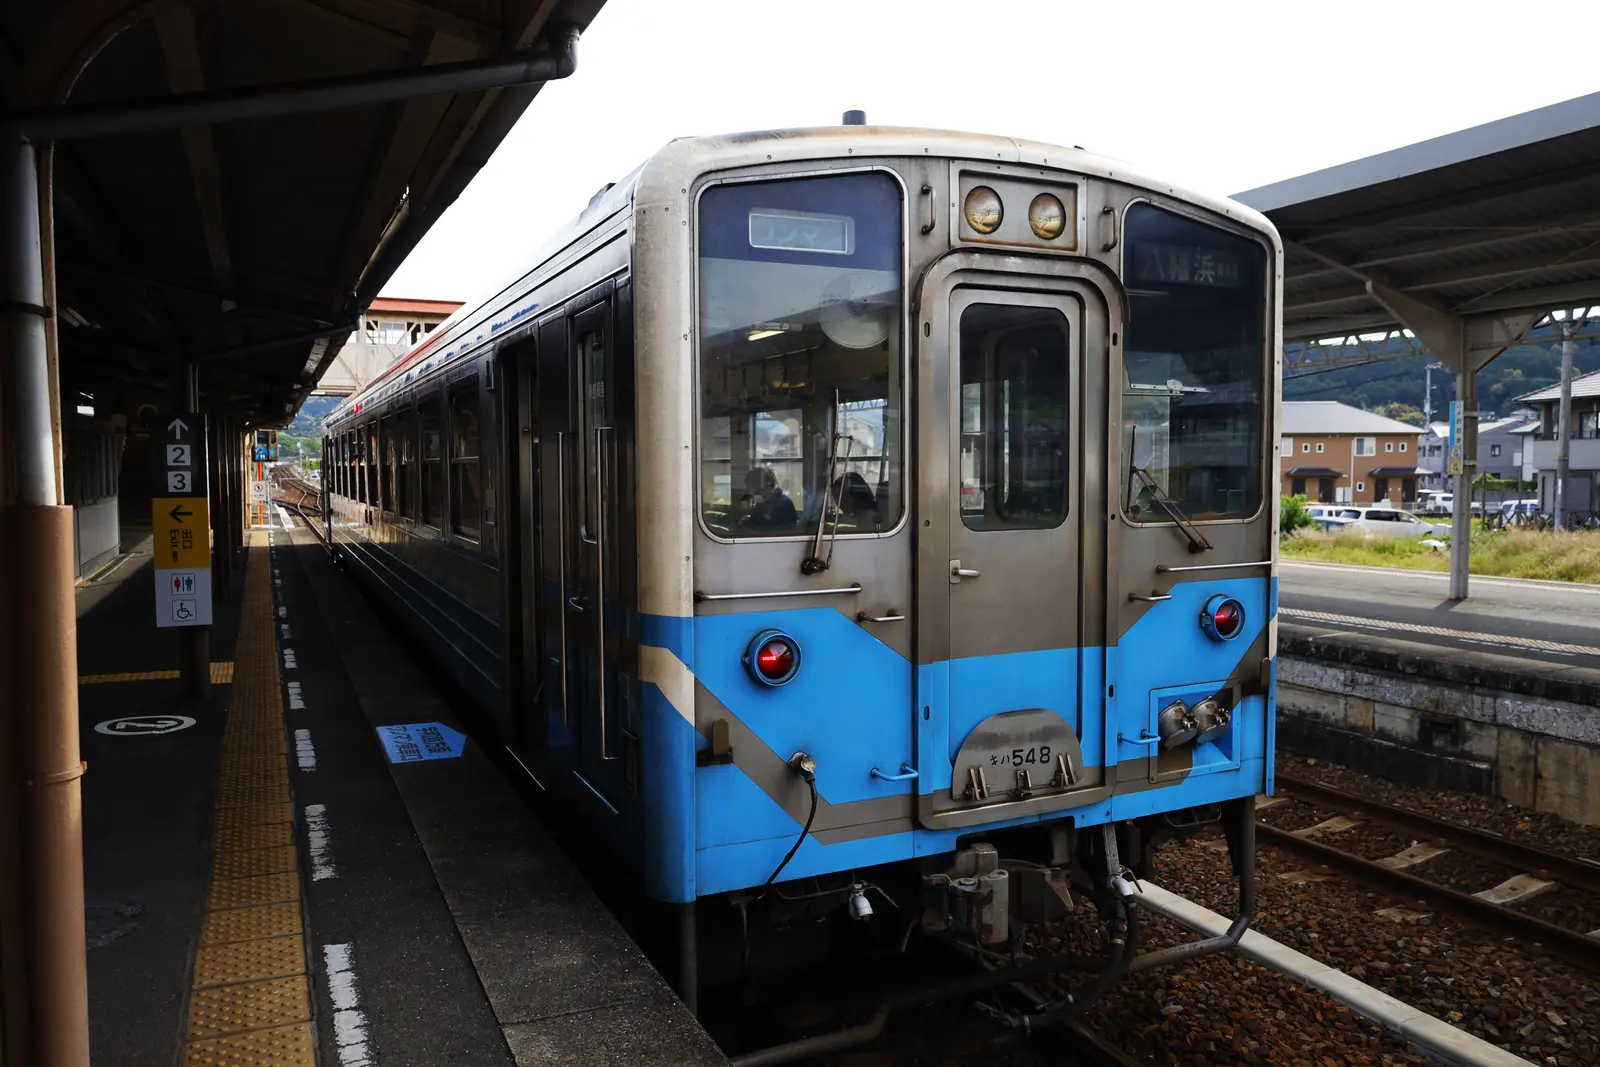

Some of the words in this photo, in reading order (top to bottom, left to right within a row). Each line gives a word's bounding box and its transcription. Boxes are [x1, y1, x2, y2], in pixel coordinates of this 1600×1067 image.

[172, 446, 186, 464] 2
[172, 473, 187, 490] 3
[170, 529, 180, 548] Exit
[182, 529, 193, 549] 出口
